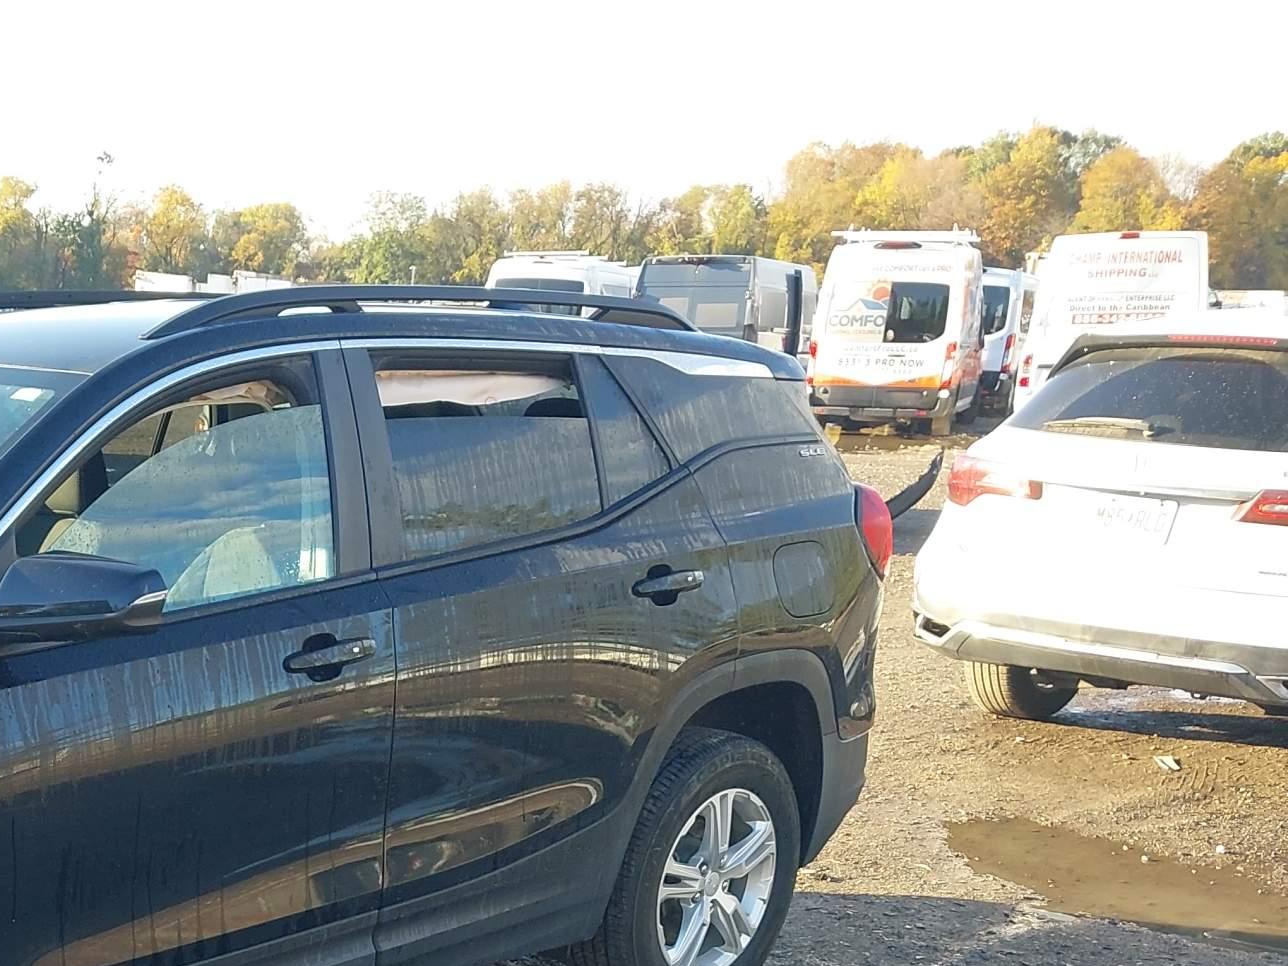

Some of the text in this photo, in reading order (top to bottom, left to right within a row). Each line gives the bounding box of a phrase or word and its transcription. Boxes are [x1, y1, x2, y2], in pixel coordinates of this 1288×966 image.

[1106, 250, 1183, 264] INTERNATIONAL
[1087, 267, 1148, 279] SHIPPING
[1069, 304, 1095, 312] Direct
[1125, 303, 1171, 311] Caribbean
[828, 314, 885, 327] COMFO
[875, 358, 896, 367] PRO
[899, 359, 925, 367] NOW
[800, 447, 825, 457] SLE
